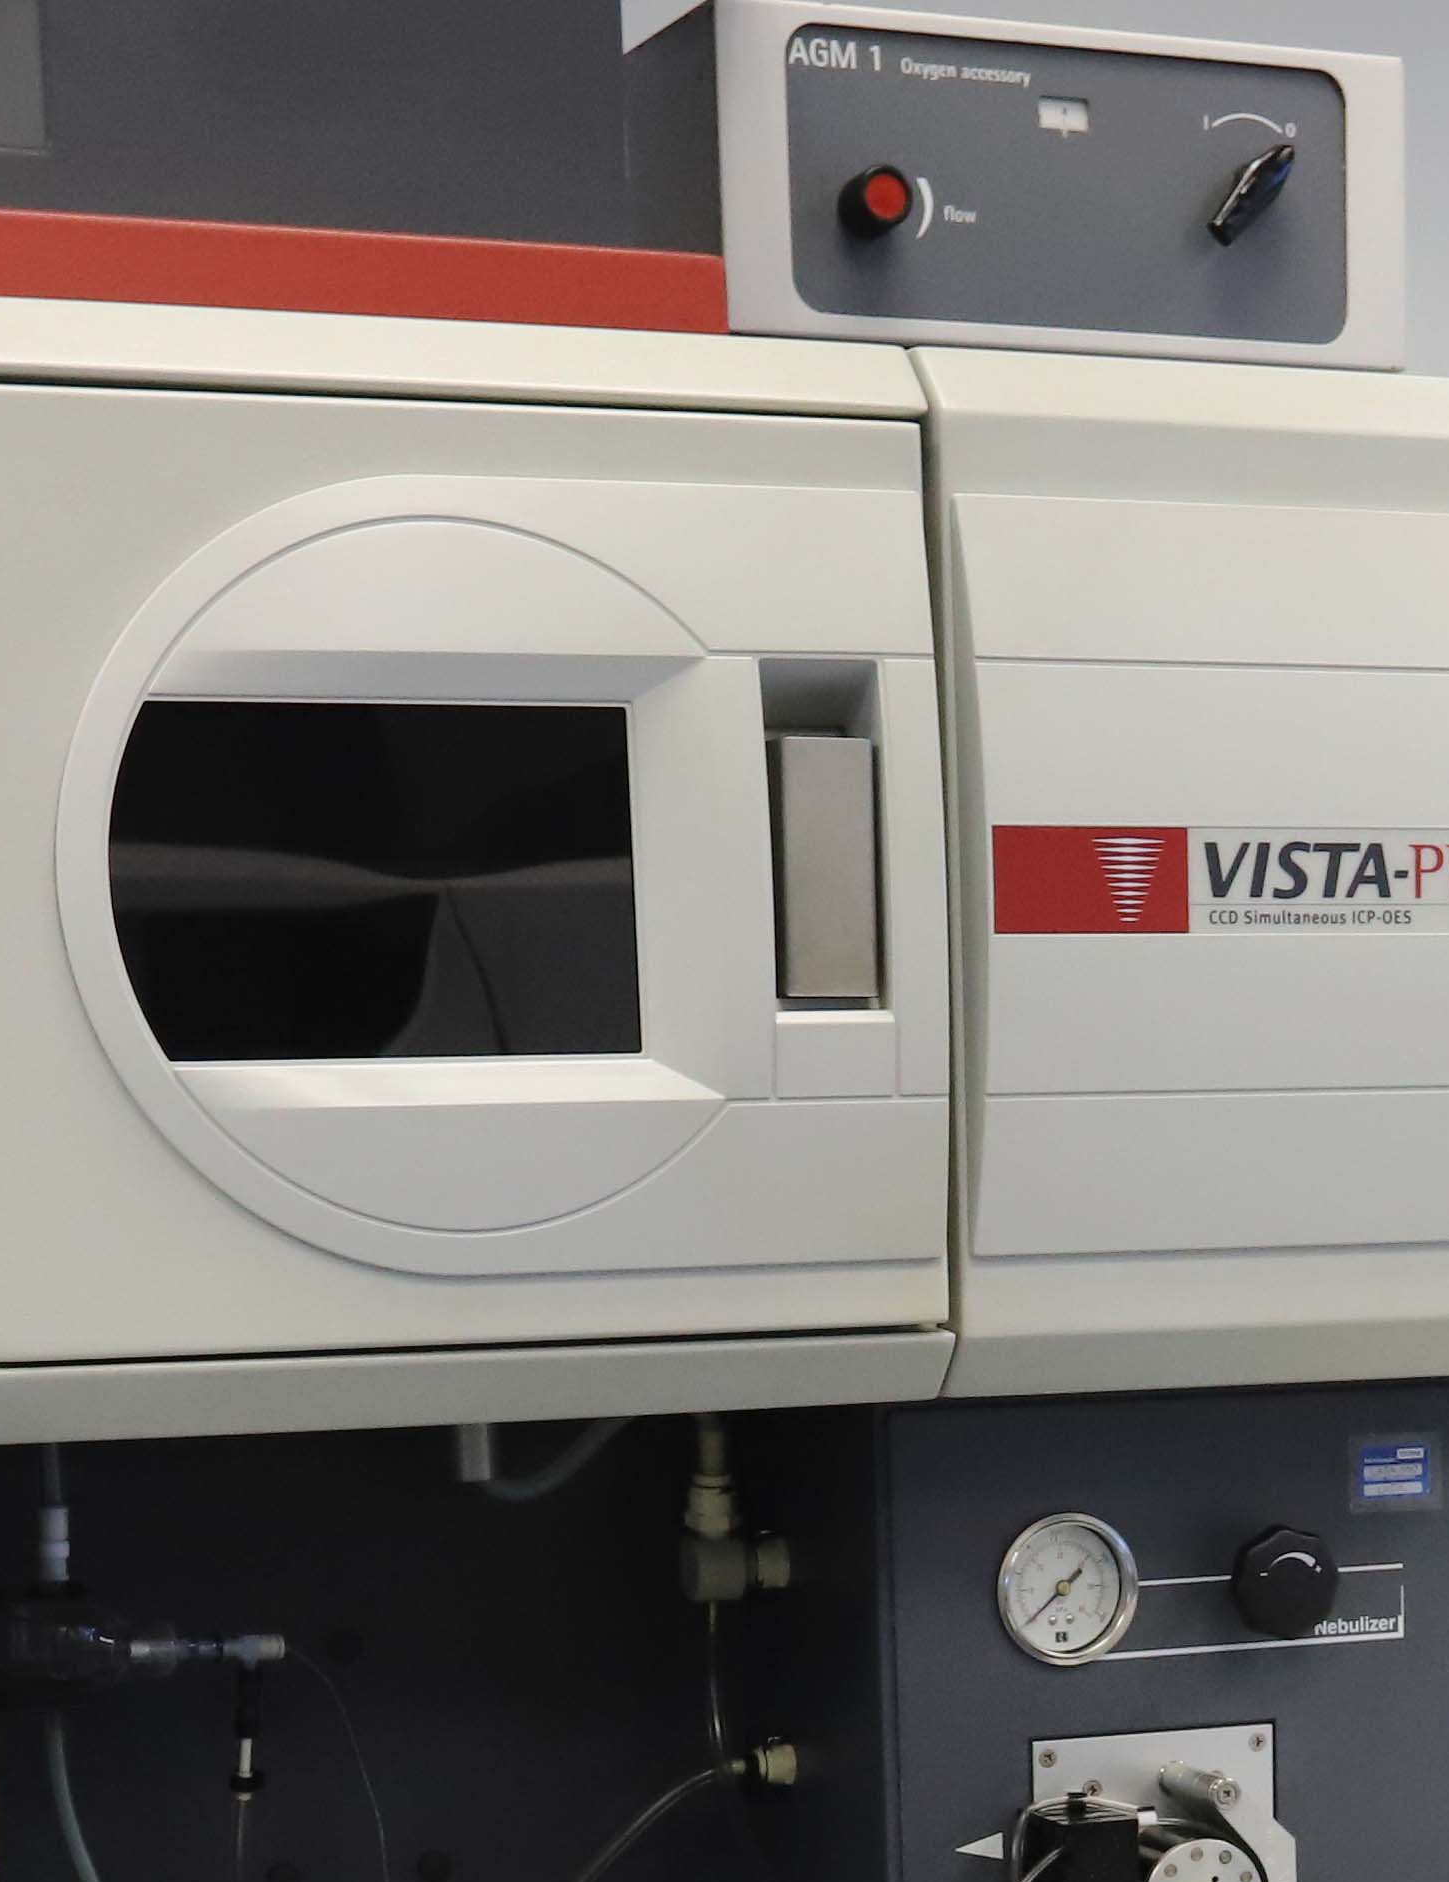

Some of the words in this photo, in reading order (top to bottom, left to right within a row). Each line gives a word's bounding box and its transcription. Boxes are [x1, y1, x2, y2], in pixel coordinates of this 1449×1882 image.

[789, 37, 857, 70] AGM
[869, 46, 882, 72] 1
[901, 57, 956, 80] Oxygen
[960, 62, 1031, 87] accessory
[943, 204, 976, 224] flow
[1209, 910, 1239, 926] CCD
[1243, 909, 1348, 926] Simultaneous
[1351, 909, 1413, 926] ICP-OES
